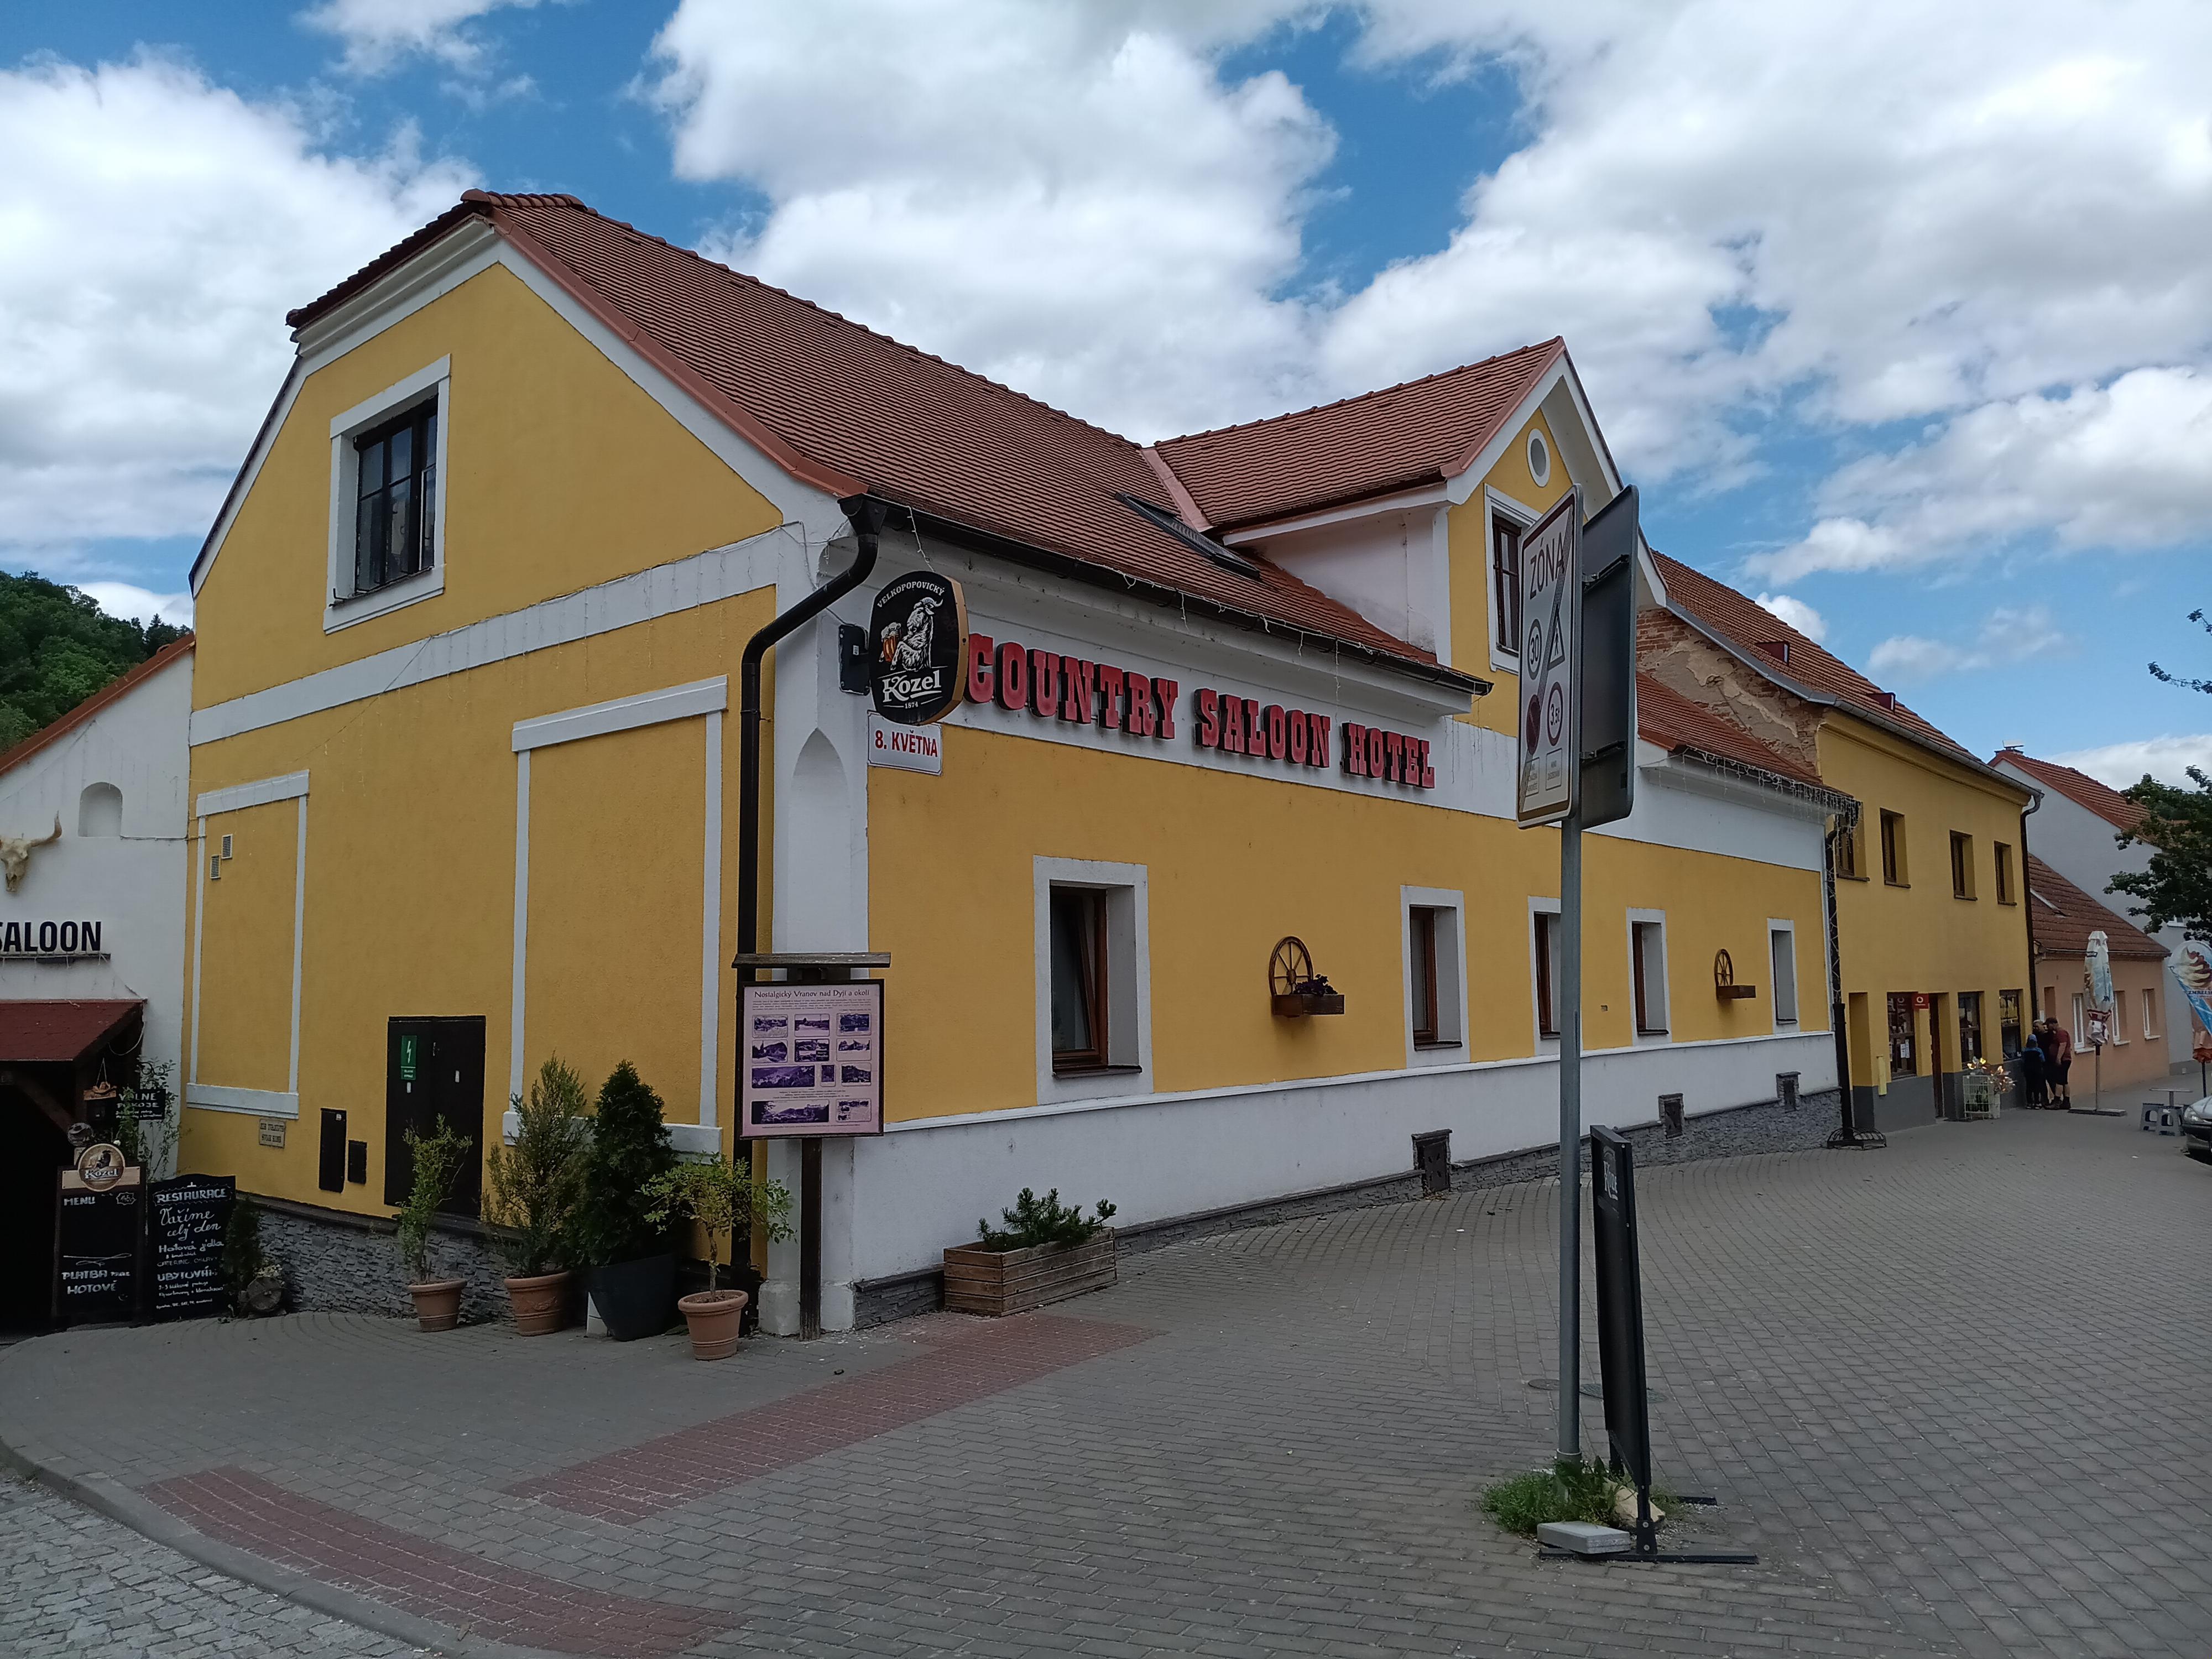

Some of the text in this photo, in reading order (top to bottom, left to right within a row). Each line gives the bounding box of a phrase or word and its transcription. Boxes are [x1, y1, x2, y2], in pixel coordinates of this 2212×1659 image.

[1530, 532, 1564, 600] ZÓNA
[877, 581, 946, 608] VELKOPOPOVICKÝ
[1530, 634, 1539, 665] 30
[883, 670, 942, 703] Kozel
[904, 701, 919, 709] 1874
[964, 633, 1436, 790] COUNTRY SALOON HOTEL
[875, 729, 938, 758] 8. KVĚTNA
[0, 921, 101, 952] ALOON
[754, 990, 791, 999] Nostalgický
[118, 1091, 160, 1101] VLNÉ
[85, 1168, 118, 1180] Kozel
[64, 1196, 96, 1206] MENU
[155, 1189, 227, 1203] RESTAURACE
[160, 1207, 215, 1225] Vaříme
[168, 1220, 221, 1241] celý den
[61, 1270, 107, 1280] PLATBA
